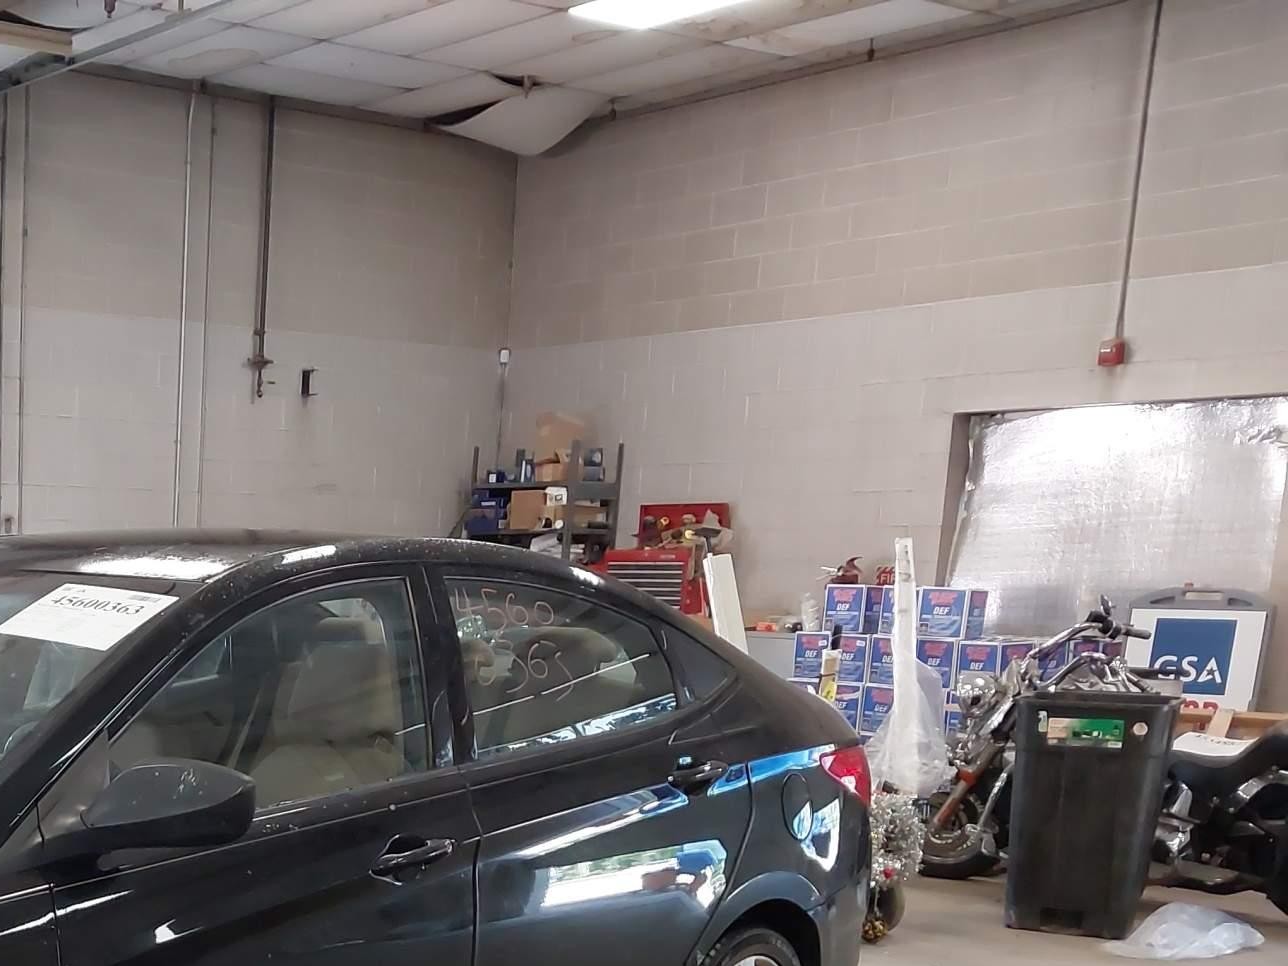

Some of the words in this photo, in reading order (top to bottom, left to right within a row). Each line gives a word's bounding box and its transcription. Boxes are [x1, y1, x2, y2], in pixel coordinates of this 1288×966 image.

[51, 595, 145, 615] 45600363
[836, 603, 850, 611] DEF
[454, 587, 554, 638] 4560
[933, 606, 950, 615] DEF
[804, 650, 818, 658] DEF
[841, 652, 855, 661] DEF
[927, 657, 941, 666] DEF
[970, 661, 984, 670] DEF
[1153, 655, 1223, 684] GSA
[874, 703, 887, 712] DEF
